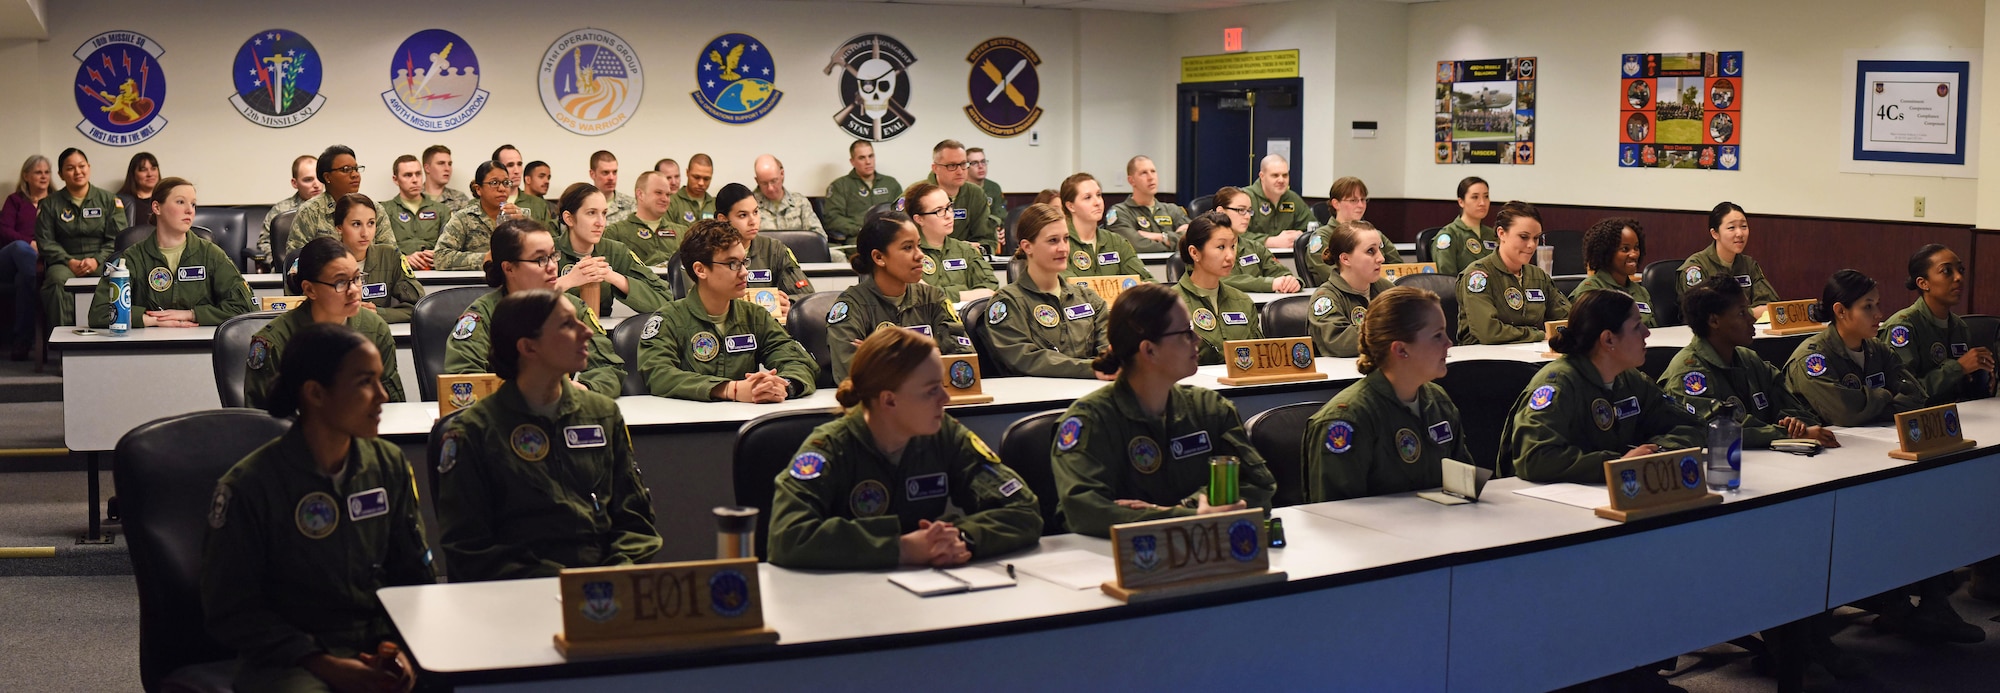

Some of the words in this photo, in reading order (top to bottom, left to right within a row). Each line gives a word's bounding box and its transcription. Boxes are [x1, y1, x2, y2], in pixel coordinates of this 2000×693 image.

[108, 33, 135, 43] MISSILE
[136, 37, 146, 47] SQ
[1223, 28, 1243, 51] EXIT
[544, 50, 560, 73] 341st
[558, 33, 615, 51] OPERATIONS
[616, 44, 638, 74] GROUP
[243, 106, 259, 121] 12th
[260, 114, 299, 125] MISSILE
[300, 106, 313, 118] SQ
[390, 98, 411, 120] 490TH
[410, 115, 443, 129] MISSILE
[444, 94, 484, 128] SQUADRON
[555, 112, 577, 128] OPS
[578, 112, 627, 132] WARRIOR
[1876, 104, 1904, 121] 4Cs
[89, 127, 107, 141] FIRST
[107, 134, 119, 144] ACE
[128, 133, 141, 142] THE
[140, 125, 155, 139] HOLE
[848, 120, 870, 135] STAN
[883, 121, 905, 136] EVAL
[1787, 303, 1809, 323] G01
[1254, 342, 1292, 369] H01
[1920, 411, 1946, 441] B01
[1643, 457, 1681, 495] C01
[1164, 522, 1226, 569] D01
[629, 570, 705, 621] E01
